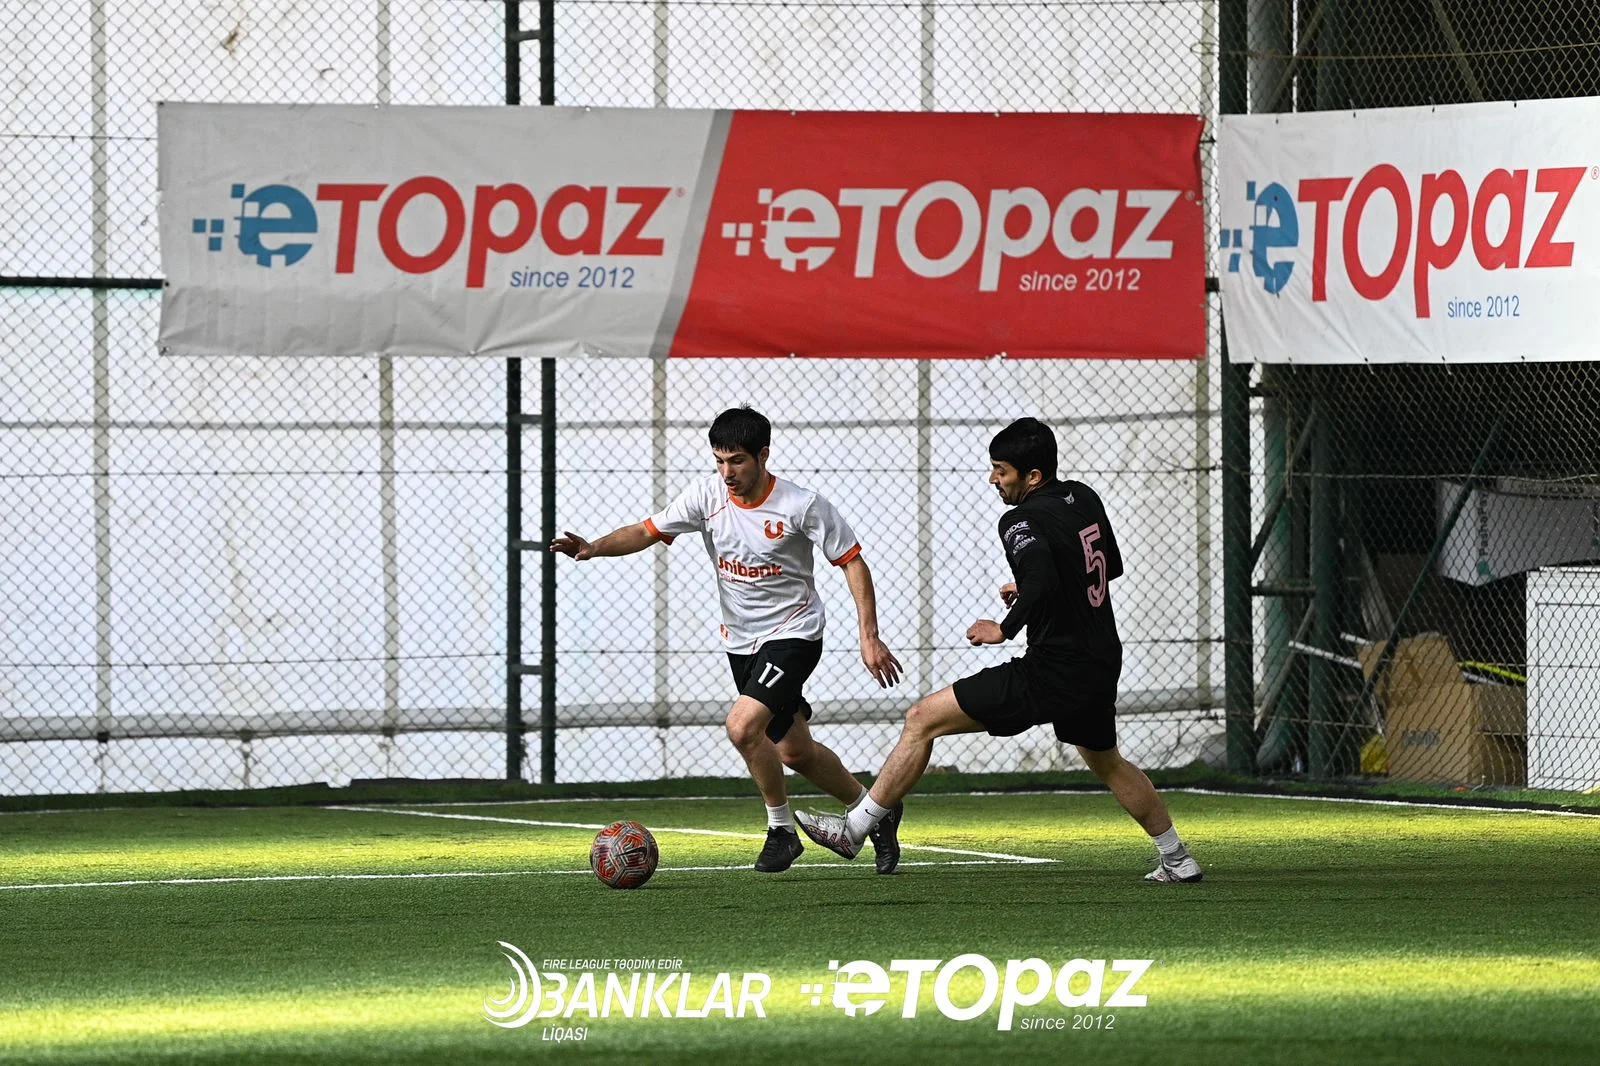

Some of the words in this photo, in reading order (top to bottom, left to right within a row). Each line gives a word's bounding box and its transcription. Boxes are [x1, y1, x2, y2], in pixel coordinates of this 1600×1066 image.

[510, 266, 569, 288] since
[578, 266, 634, 288] 2012
[1019, 270, 1078, 291] since
[1085, 268, 1141, 291] 2012
[1447, 297, 1482, 318] since
[1487, 296, 1520, 317] 2012
[1078, 522, 1107, 608] 5
[758, 662, 785, 688] 17
